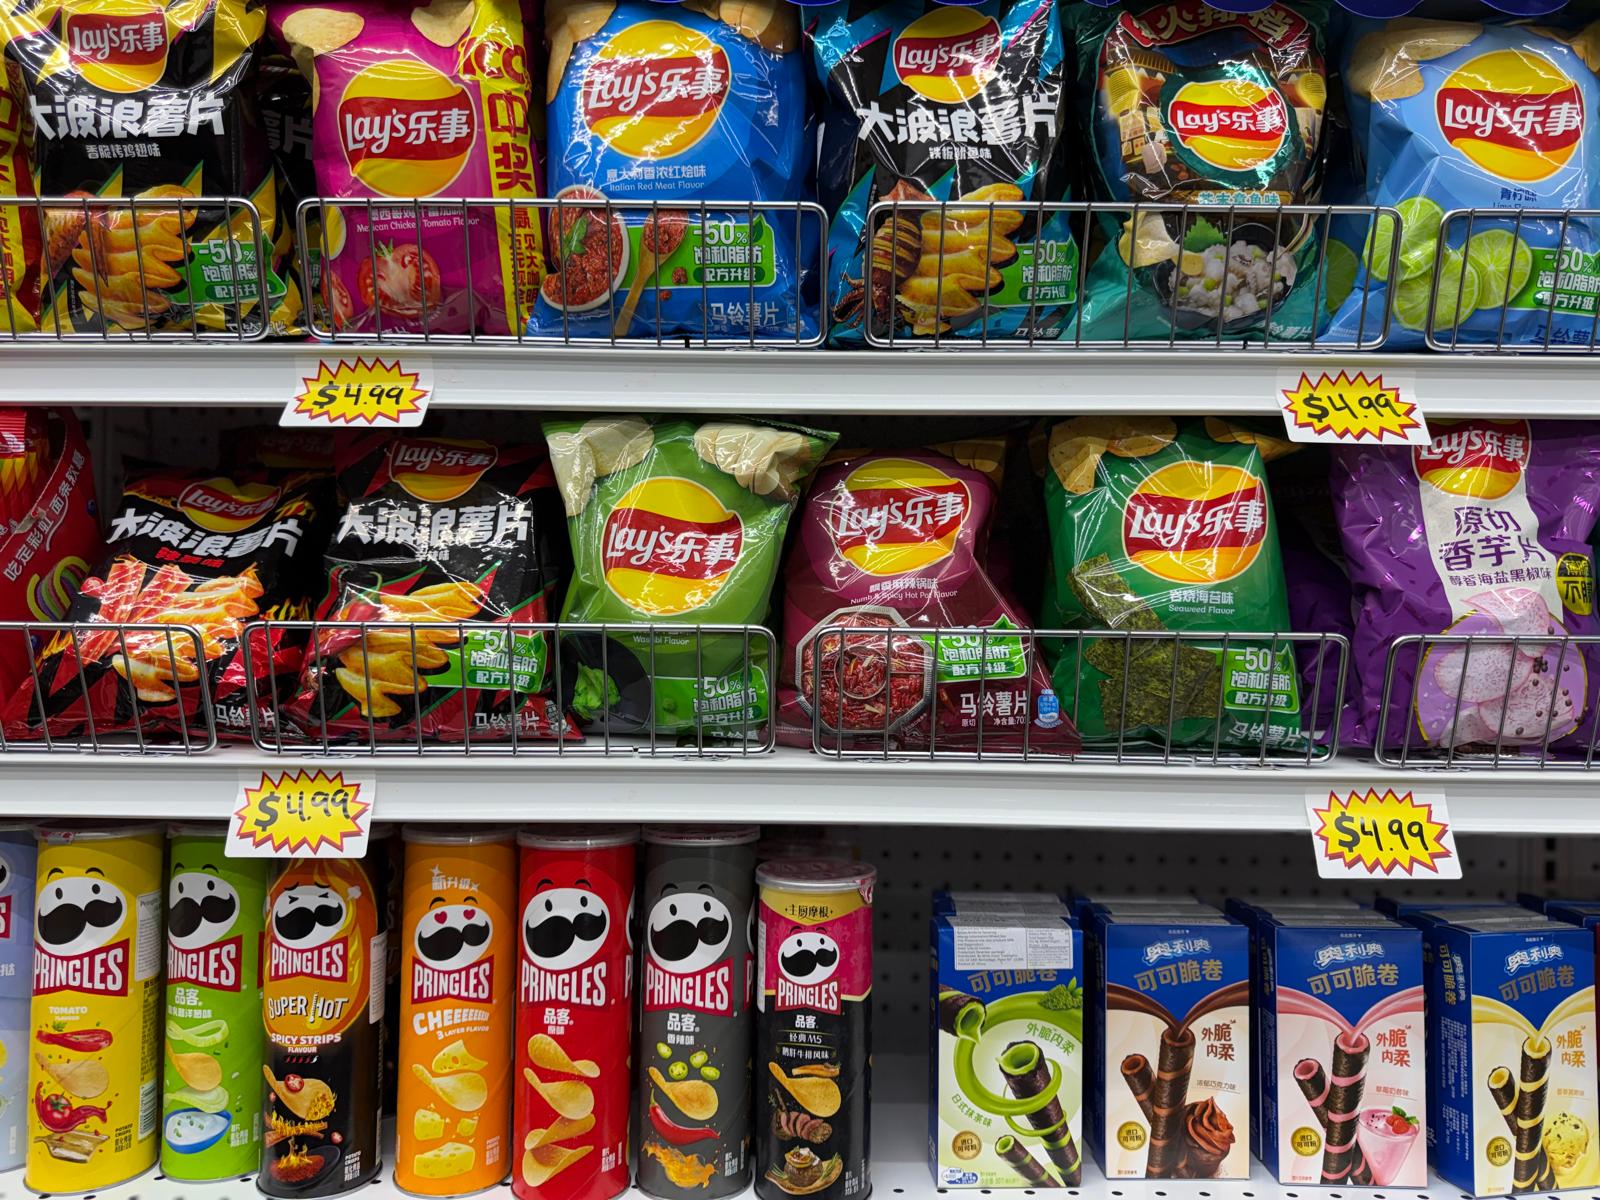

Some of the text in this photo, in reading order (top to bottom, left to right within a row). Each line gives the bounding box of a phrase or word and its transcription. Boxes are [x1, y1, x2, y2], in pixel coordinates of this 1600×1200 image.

[72, 21, 165, 59] Lay's乐事
[900, 33, 998, 73] Lay's乐事
[588, 66, 722, 112] Lay's乐事
[30, 94, 225, 139] 大波浪薯片
[346, 108, 471, 153] Lay's乐事
[857, 93, 1056, 146] 大波浪薯片
[1177, 106, 1282, 133] Lay's乐事
[1444, 97, 1581, 137] Lay's乐事
[637, 182, 653, 191] Red
[655, 182, 676, 190] Meat
[678, 181, 704, 190] Flavor
[357, 220, 389, 233] Meican
[390, 217, 418, 231] Chicke
[422, 218, 452, 229] Tomato
[694, 219, 748, 246] -50%
[313, 380, 403, 410] $4.99
[1303, 392, 1402, 423] $4.99
[106, 508, 305, 558] 大波浪薯片
[337, 502, 533, 546] 大波浪薯片
[838, 492, 966, 541] Lay's乐事
[1130, 499, 1265, 546] Lay's乐事
[1454, 506, 1521, 537] 原切
[607, 522, 741, 566] Lay's乐事
[1439, 534, 1546, 571] 香芋片
[905, 589, 918, 599] Hot
[1169, 604, 1236, 615] Seaweed Flavor
[633, 635, 662, 644] Wasbi
[254, 789, 351, 832] $4.99
[1334, 811, 1429, 853] $4.99
[34, 943, 125, 991] PRINGLES
[168, 943, 236, 988] RINGLES
[269, 942, 344, 979] PRINGLES
[1134, 959, 1223, 991] 可可脆卷
[175, 987, 199, 1006] 品客
[413, 962, 489, 1003] PRINGLES
[521, 959, 607, 1006] PRINGLES
[645, 961, 730, 1011] PRINGLES
[777, 977, 838, 1012] PRINGLES
[1306, 964, 1399, 996] 可可脆卷
[1499, 965, 1575, 1002] 可可脆卷
[48, 1006, 88, 1016] TOMATO
[268, 995, 307, 1020] SUPER
[544, 1008, 571, 1025] 品客
[667, 1012, 696, 1033] 品客
[795, 1015, 816, 1029] 品客
[271, 1033, 342, 1045] SPICY STRIPS
[1026, 1022, 1075, 1056] 外脆内柔
[1201, 1022, 1232, 1042] 外脆
[1376, 1028, 1407, 1048] 外脆
[1556, 1030, 1583, 1049] 外脆
[1206, 1043, 1235, 1061] 内柔
[1382, 1049, 1411, 1067] 内柔
[1561, 1050, 1586, 1068] 内柔
[952, 1093, 993, 1129] 日式抹茶味
